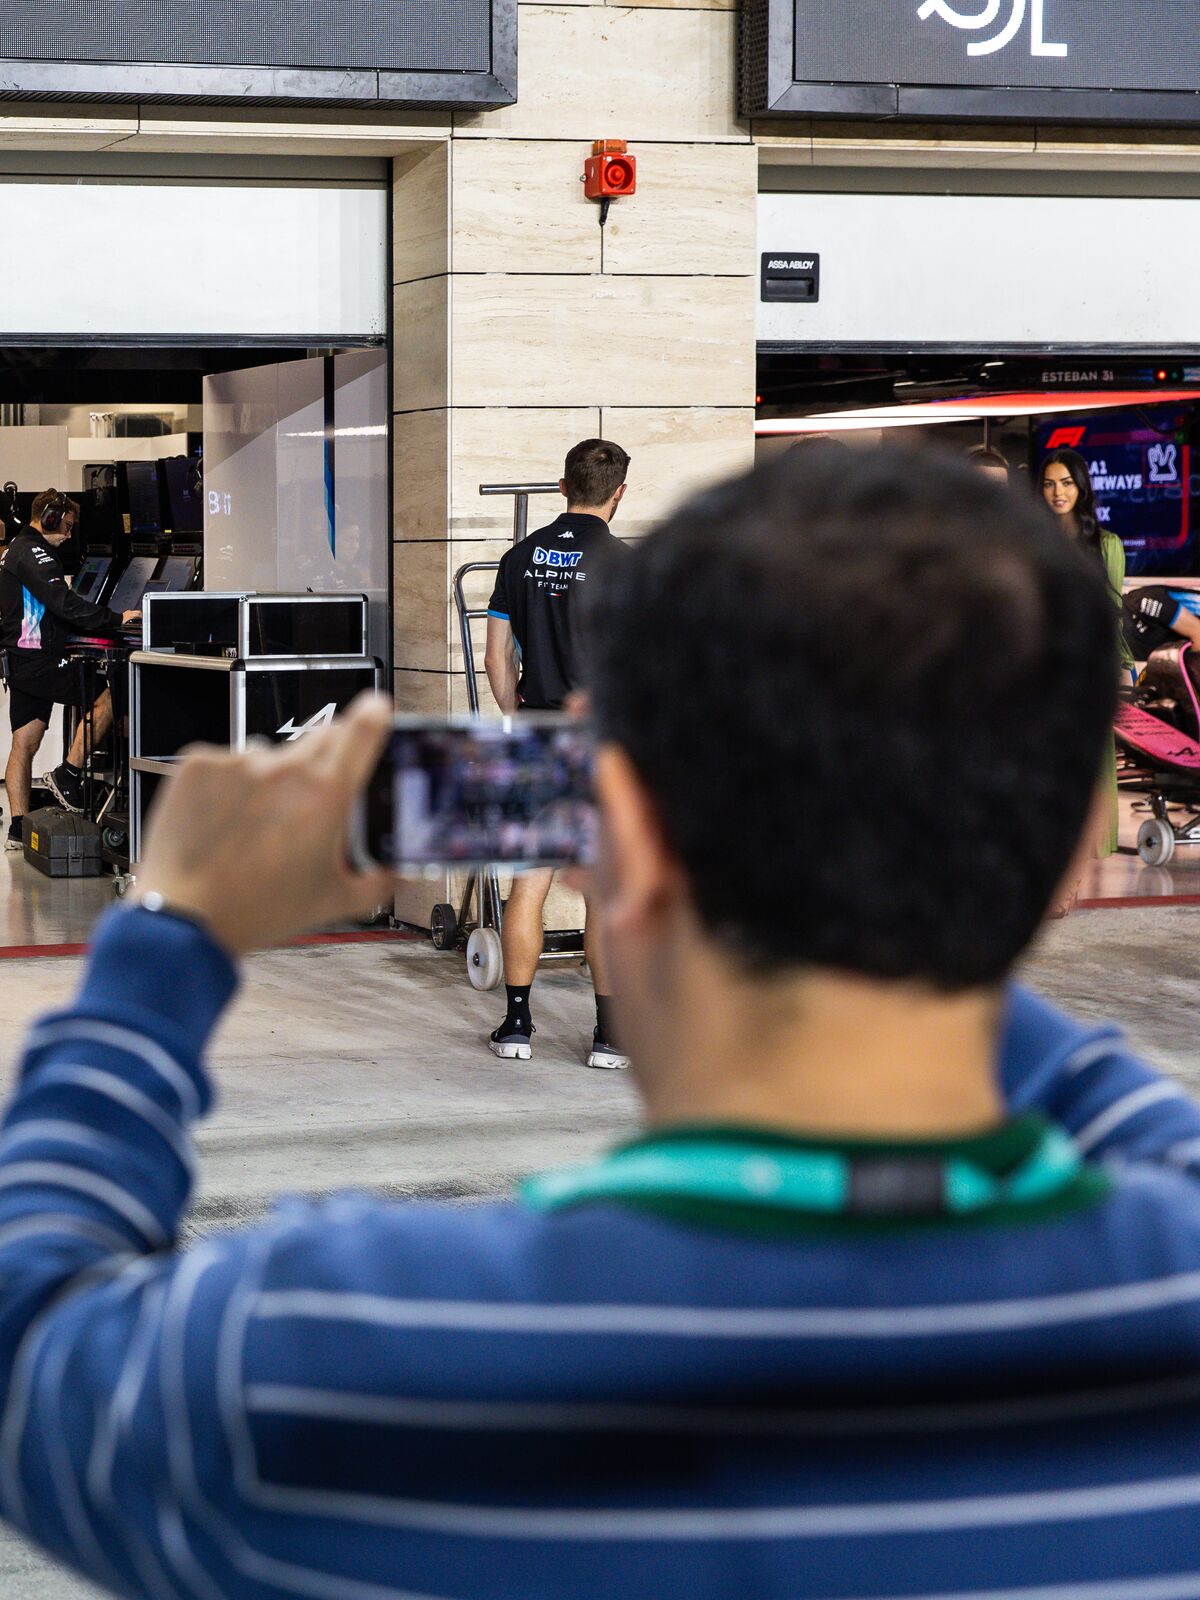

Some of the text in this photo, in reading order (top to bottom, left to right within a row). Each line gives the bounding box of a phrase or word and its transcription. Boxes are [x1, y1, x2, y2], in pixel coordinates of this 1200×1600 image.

[767, 260, 815, 270] ASSA ABLOY
[1042, 371, 1097, 382] ESTEBAN
[1091, 475, 1142, 491] IRWAYS
[547, 549, 583, 567] BWT
[523, 569, 587, 581] ALPINE
